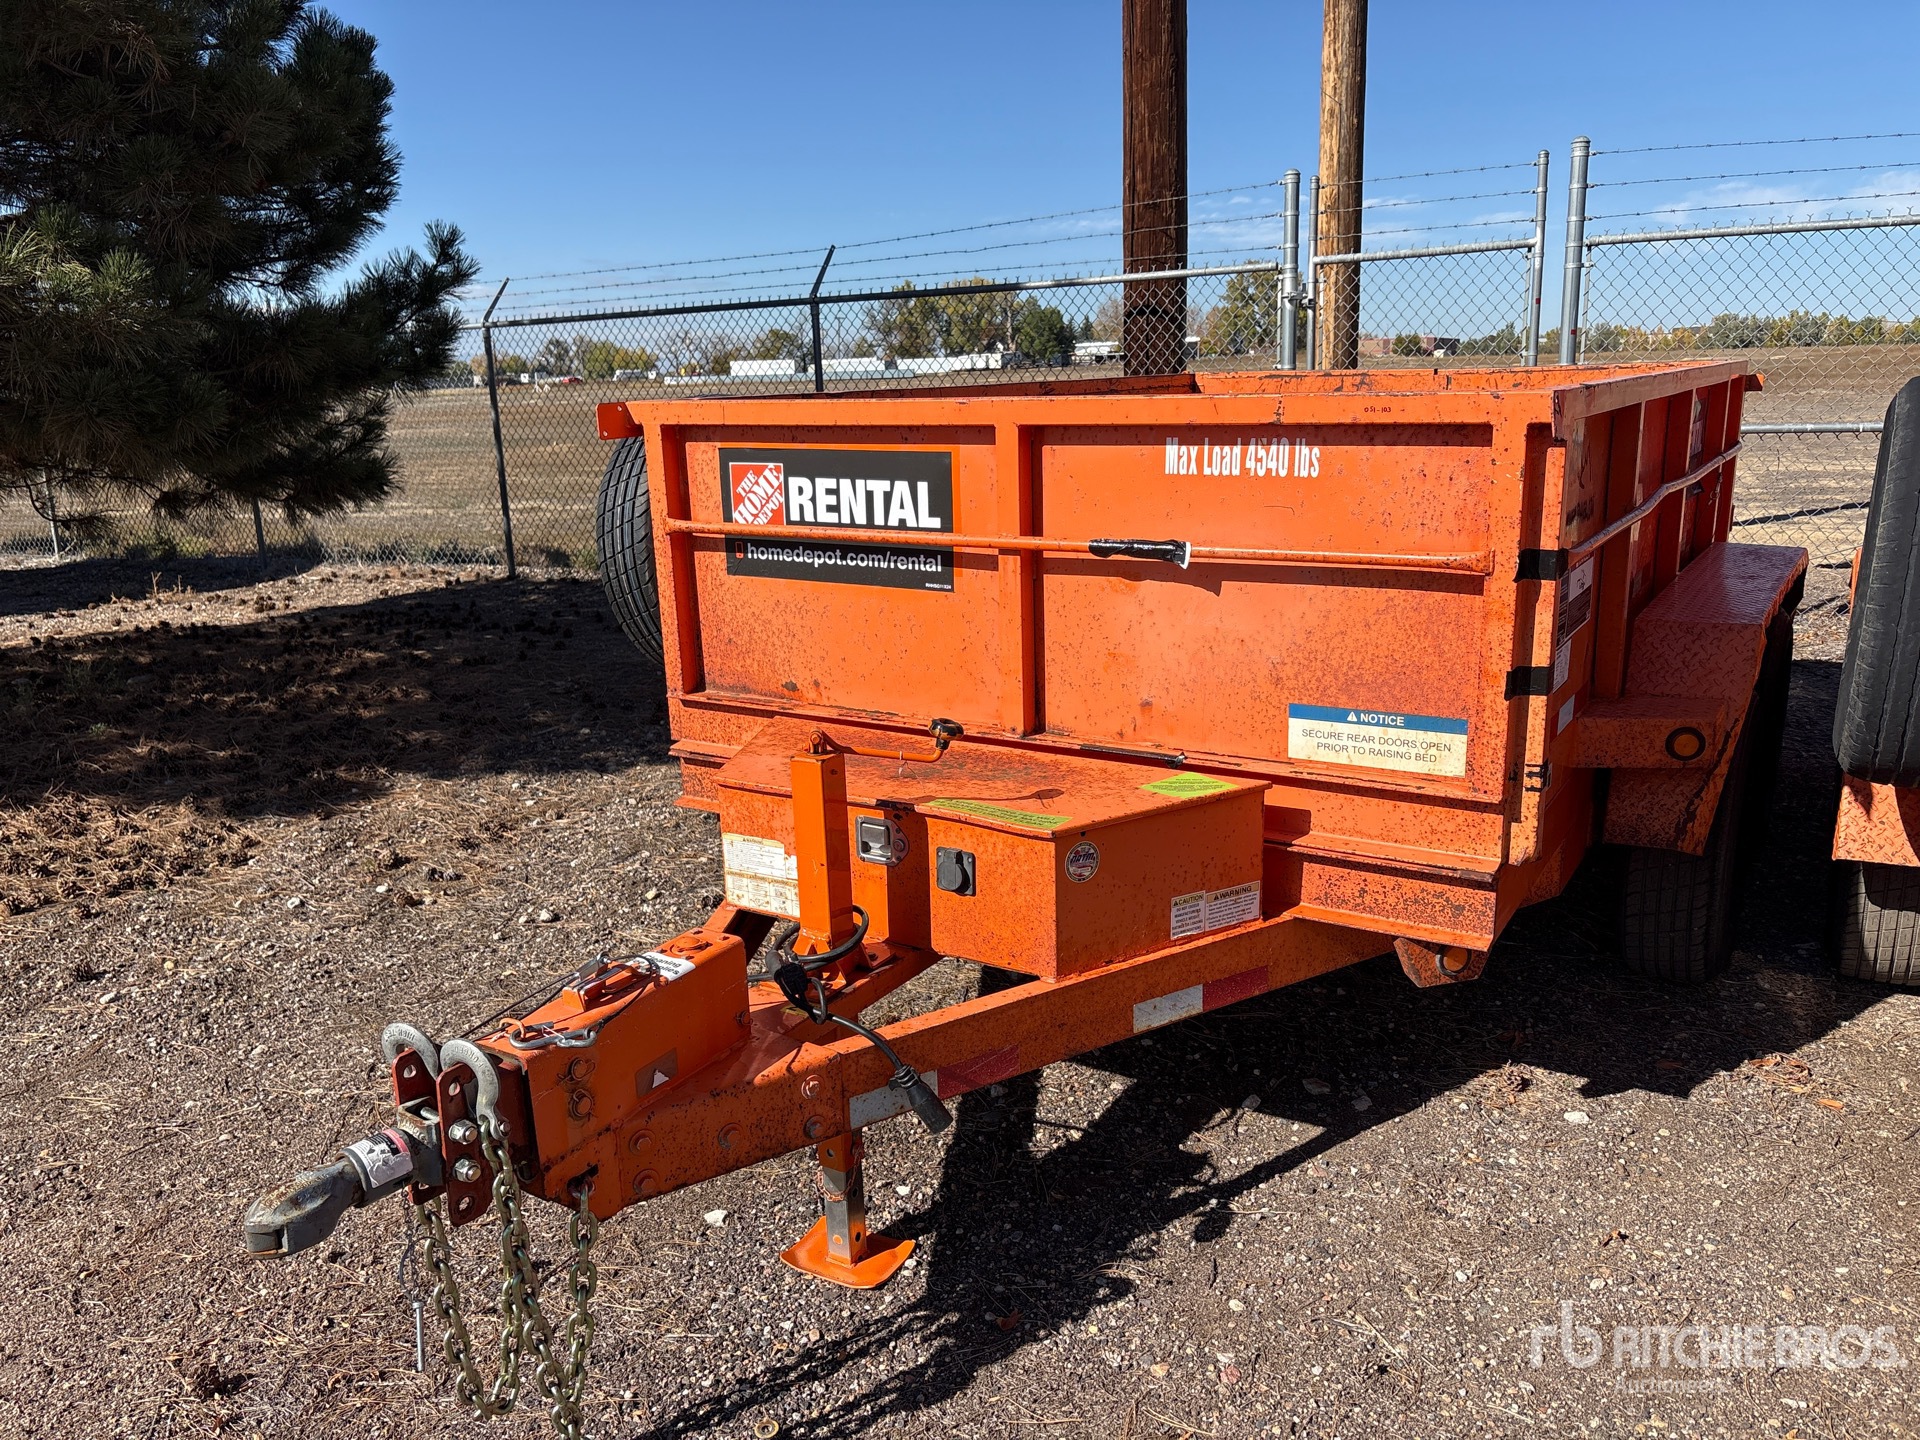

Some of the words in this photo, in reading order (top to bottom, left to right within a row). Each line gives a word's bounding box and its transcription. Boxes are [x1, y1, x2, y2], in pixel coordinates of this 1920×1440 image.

[1164, 437, 1198, 475] Max
[1203, 437, 1242, 476] Load
[1245, 437, 1289, 478] 4540
[1293, 437, 1321, 478] lbs
[733, 463, 783, 525] HOME
[736, 469, 758, 498] THE
[752, 488, 784, 525] DEPOT
[788, 476, 942, 529] RENTAL
[747, 542, 942, 573] homedepot.com/rental
[1360, 713, 1404, 726] NOTICE
[1302, 728, 1344, 741] SECURE
[1346, 733, 1376, 745] REAR
[1378, 736, 1418, 749] DOORS
[1420, 741, 1452, 752] OPEN
[1316, 742, 1349, 754] PRIOR
[1352, 745, 1366, 755] TO
[1368, 748, 1412, 761] RAISING
[1415, 753, 1437, 763] BED
[1178, 894, 1203, 905] CAUTION
[1219, 886, 1252, 899] WARNING
